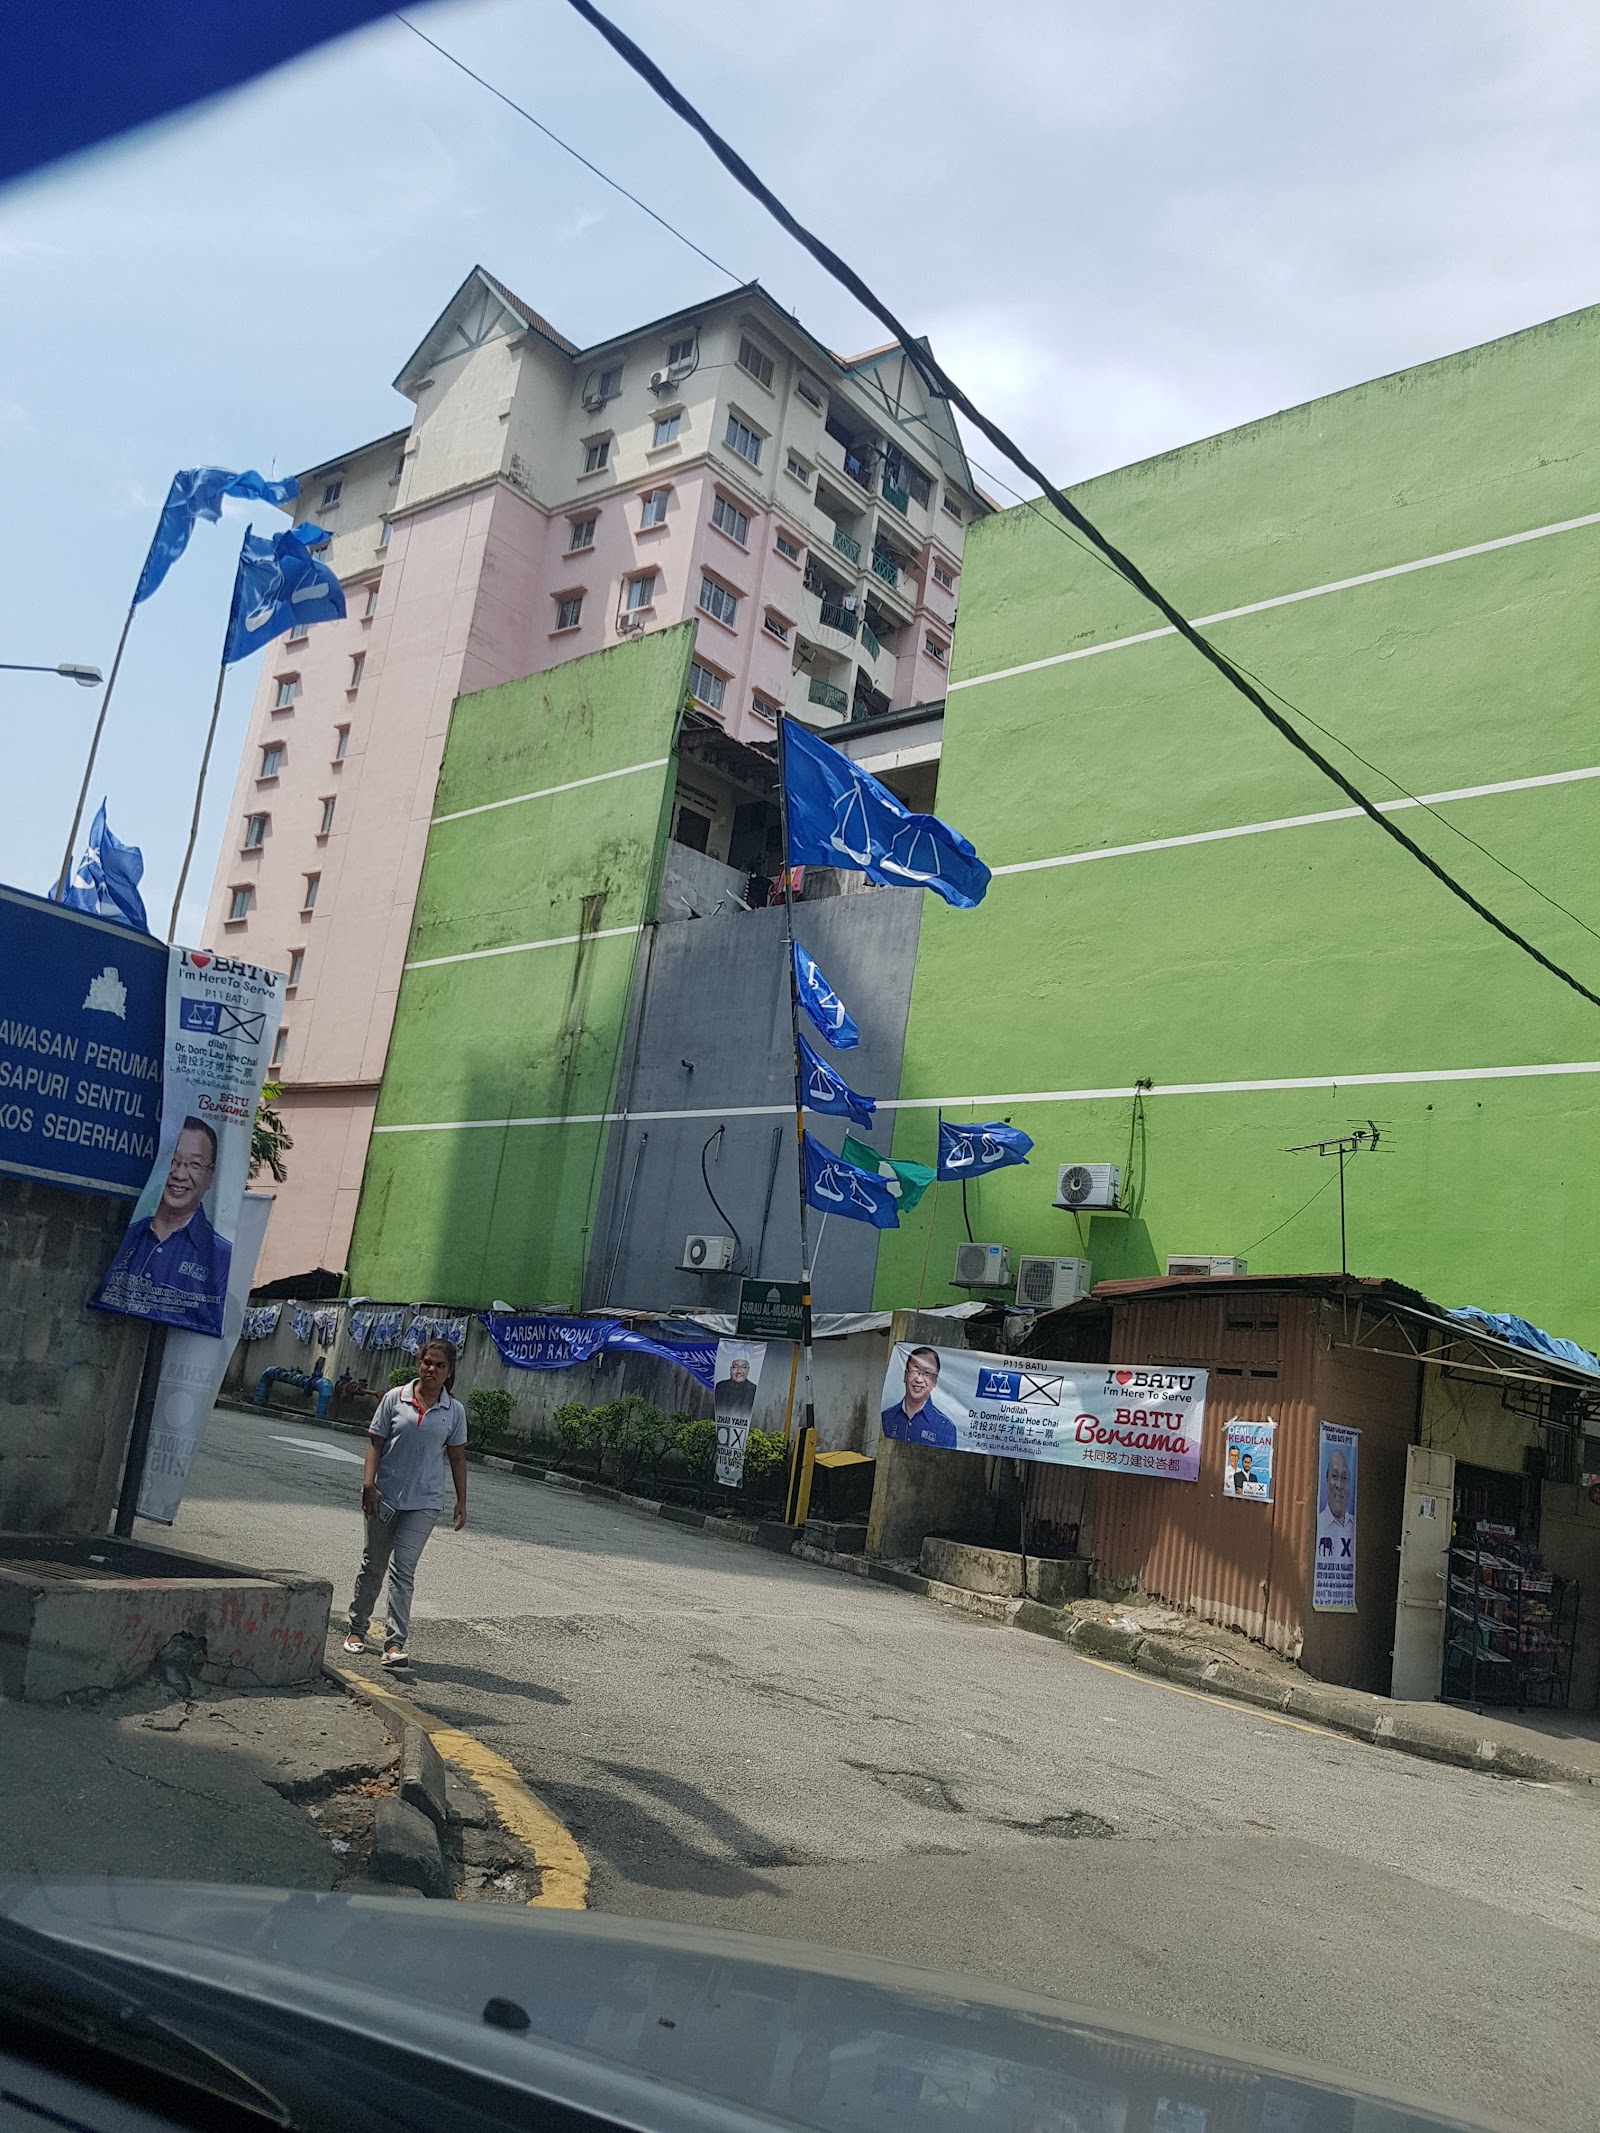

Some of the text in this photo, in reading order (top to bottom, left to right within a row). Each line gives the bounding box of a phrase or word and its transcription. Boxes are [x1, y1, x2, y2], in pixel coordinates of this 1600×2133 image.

[179, 968, 196, 981] I'm
[242, 981, 276, 999] Serve
[84, 1041, 164, 1083] PERUMA
[209, 1048, 224, 1060] Lau
[75, 1080, 145, 1118] SENTUL
[42, 1112, 154, 1160] SEDERHANA
[741, 1301, 763, 1315] SURAU
[762, 1302, 804, 1319] AL-MUBARAK
[504, 1324, 546, 1342] BARISAN
[1003, 1359, 1048, 1372] P115 BATU
[1133, 1372, 1196, 1390] BATU
[1103, 1386, 1192, 1403] I'm Here To Serve
[968, 1409, 1060, 1428] Dr. Dominic Lau Hoe Chai
[1001, 1405, 1028, 1415] Undilah
[1114, 1408, 1184, 1431] BATU
[1074, 1413, 1190, 1454] Bersama
[1228, 1426, 1249, 1435] DEMI
[1228, 1434, 1272, 1446] KEADILAN
